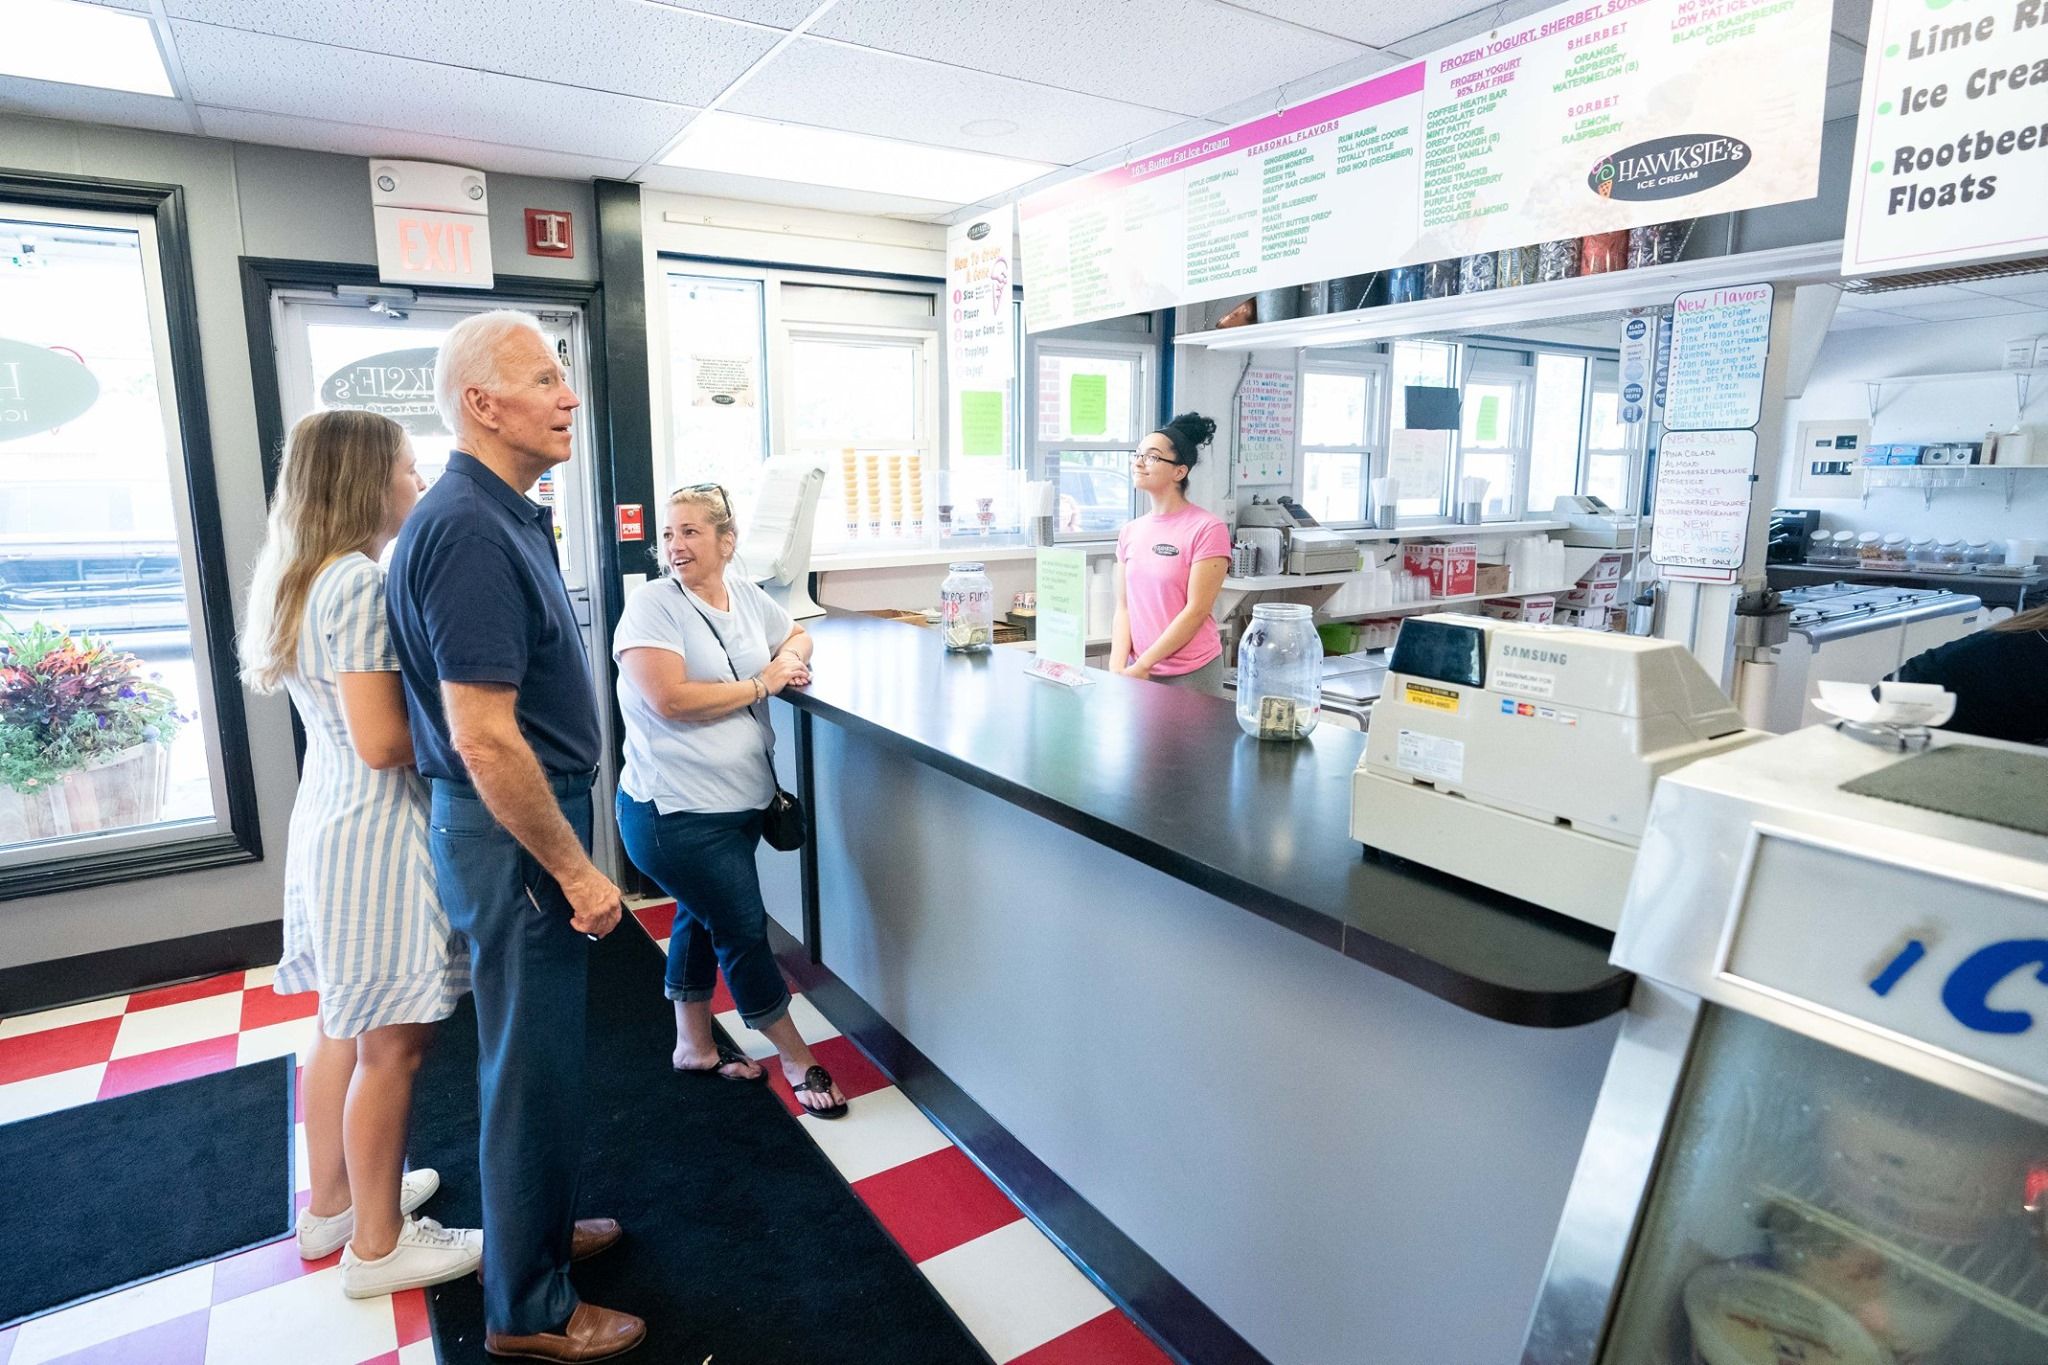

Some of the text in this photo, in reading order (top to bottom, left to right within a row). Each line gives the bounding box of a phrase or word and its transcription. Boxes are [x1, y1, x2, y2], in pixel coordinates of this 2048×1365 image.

[1671, 14, 1698, 30] LOW
[1702, 5, 1724, 20] FAT
[1727, 0, 1748, 14] ICE
[1672, 1, 1795, 44] BLACK RASPBERRY
[1440, 5, 1603, 73] FROZEN YOGURT, SHERBET,
[1567, 22, 1628, 50] SHERBET
[1706, 24, 1755, 46] COFFEE
[1908, 16, 1994, 60] Lime
[1564, 53, 1627, 78] RASPBERRY
[1574, 44, 1617, 64] ORANGE
[1451, 57, 1522, 89] FROZEN YOGURT
[1457, 71, 1515, 98] 95% FAT FREE
[1553, 66, 1622, 93] WATERMELON
[1427, 89, 1507, 120] COFFEE HEATH BAR
[1568, 96, 1620, 117] SORBET
[1900, 84, 1948, 116] Ice
[1427, 102, 1496, 129] CHOCOLATE CHIP
[1575, 114, 1610, 130] LEMON
[1247, 120, 1340, 158] SEASONAL FLAVORS
[1338, 125, 1377, 144] RUM RAISIN
[1338, 126, 1408, 154] TOLL HOUSE COOKIE
[1426, 120, 1471, 139] MINT PATTY
[1454, 126, 1485, 142] COOKIE
[1562, 122, 1624, 144] RASPBERRY
[1149, 156, 1172, 170] Butter
[1174, 151, 1186, 162] Fat
[1202, 137, 1231, 154] Cream
[1337, 141, 1394, 165] TOTALLY TURTLE
[1425, 143, 1455, 159] COOKIE
[1457, 136, 1487, 151] DOUGH
[1425, 145, 1492, 169] FRENCH VANILLA
[1263, 155, 1314, 175] GREEN MONSTER
[1337, 147, 1413, 175] EGG NOG (DECEMBER)
[1425, 162, 1465, 179] PISTACHIO
[1618, 139, 1744, 182] HAWKSIE's
[1263, 171, 1296, 185] GREEN TEA
[1285, 172, 1325, 189] BAR CRUNCH
[1424, 173, 1503, 198] BLACK RASPBERRY
[1425, 166, 1488, 188] MOOSE TRACKS
[1637, 171, 1698, 190] ICE CREAM
[1262, 194, 1318, 214] MAINE BLUEBERRY
[1424, 190, 1476, 208] PURPLE COW
[1888, 173, 1998, 215] Floats
[1424, 200, 1471, 217] CHOCOLATE
[1424, 203, 1509, 227] CHOCOLATE ALMOND
[1262, 215, 1310, 233] PEANUT BUTTER
[396, 218, 473, 274] EXIT
[1262, 240, 1287, 252] PUMPKIN
[1262, 248, 1300, 261] ROCKY ROAD
[1678, 289, 1766, 312] New Flavors
[1682, 308, 1751, 325] Unicorn Delight
[1503, 645, 1567, 665] SAMSUNG
